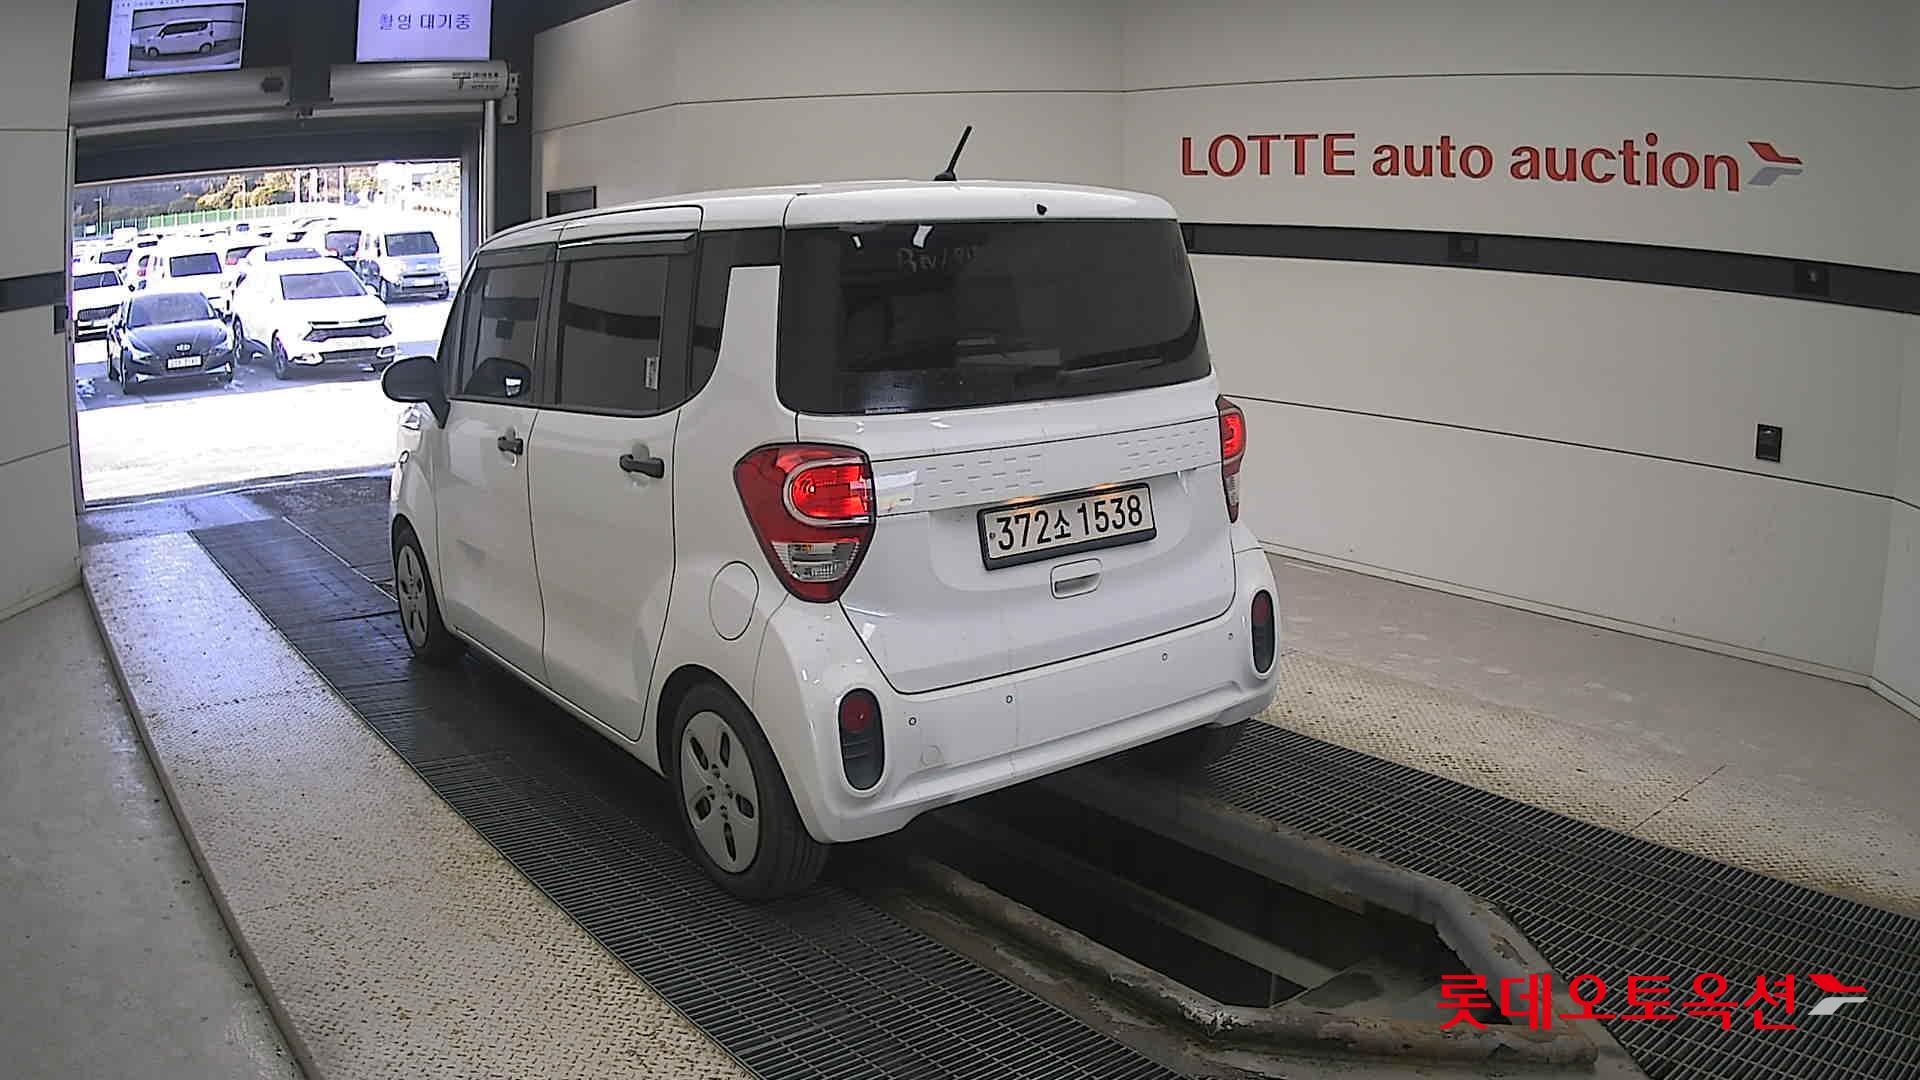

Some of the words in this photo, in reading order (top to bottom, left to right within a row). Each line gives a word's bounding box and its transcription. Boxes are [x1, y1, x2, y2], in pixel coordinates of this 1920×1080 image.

[419, 14, 472, 30] 대기중
[1180, 132, 1356, 178] LOTTE
[1371, 135, 1495, 179] auto
[1510, 132, 1741, 192] auction
